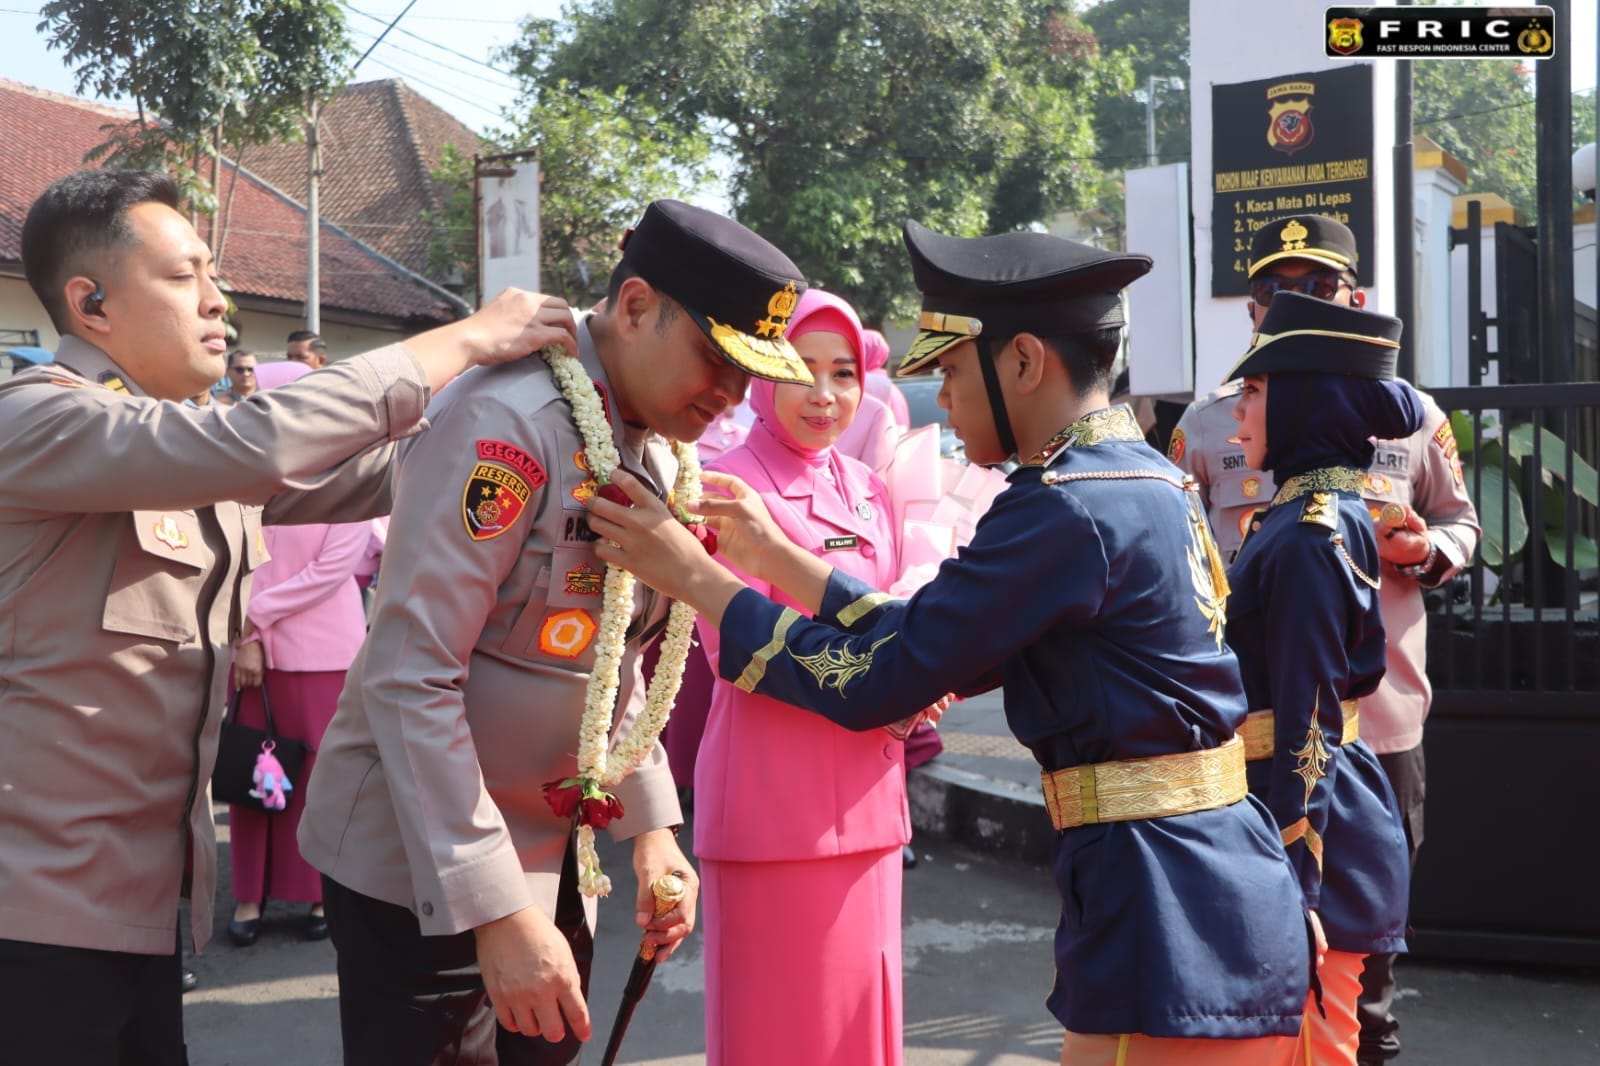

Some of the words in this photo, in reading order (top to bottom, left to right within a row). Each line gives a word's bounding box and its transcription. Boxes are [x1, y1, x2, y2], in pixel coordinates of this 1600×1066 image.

[1215, 172, 1240, 191] MOHON
[1241, 169, 1259, 188] MAAF
[1260, 165, 1306, 187] KENYAMANAN
[1307, 162, 1325, 182] ANDA
[1326, 158, 1368, 181] TERGANGGU
[1234, 201, 1244, 214] 1.
[1247, 199, 1274, 213] Kaca
[1276, 196, 1303, 210] Mata
[1305, 193, 1317, 207] Di
[1319, 192, 1352, 207] Lepas
[1234, 219, 1244, 233] 2.
[483, 442, 544, 484] GEGANA
[1376, 452, 1405, 467] LRI
[477, 465, 530, 500] RESERSE
